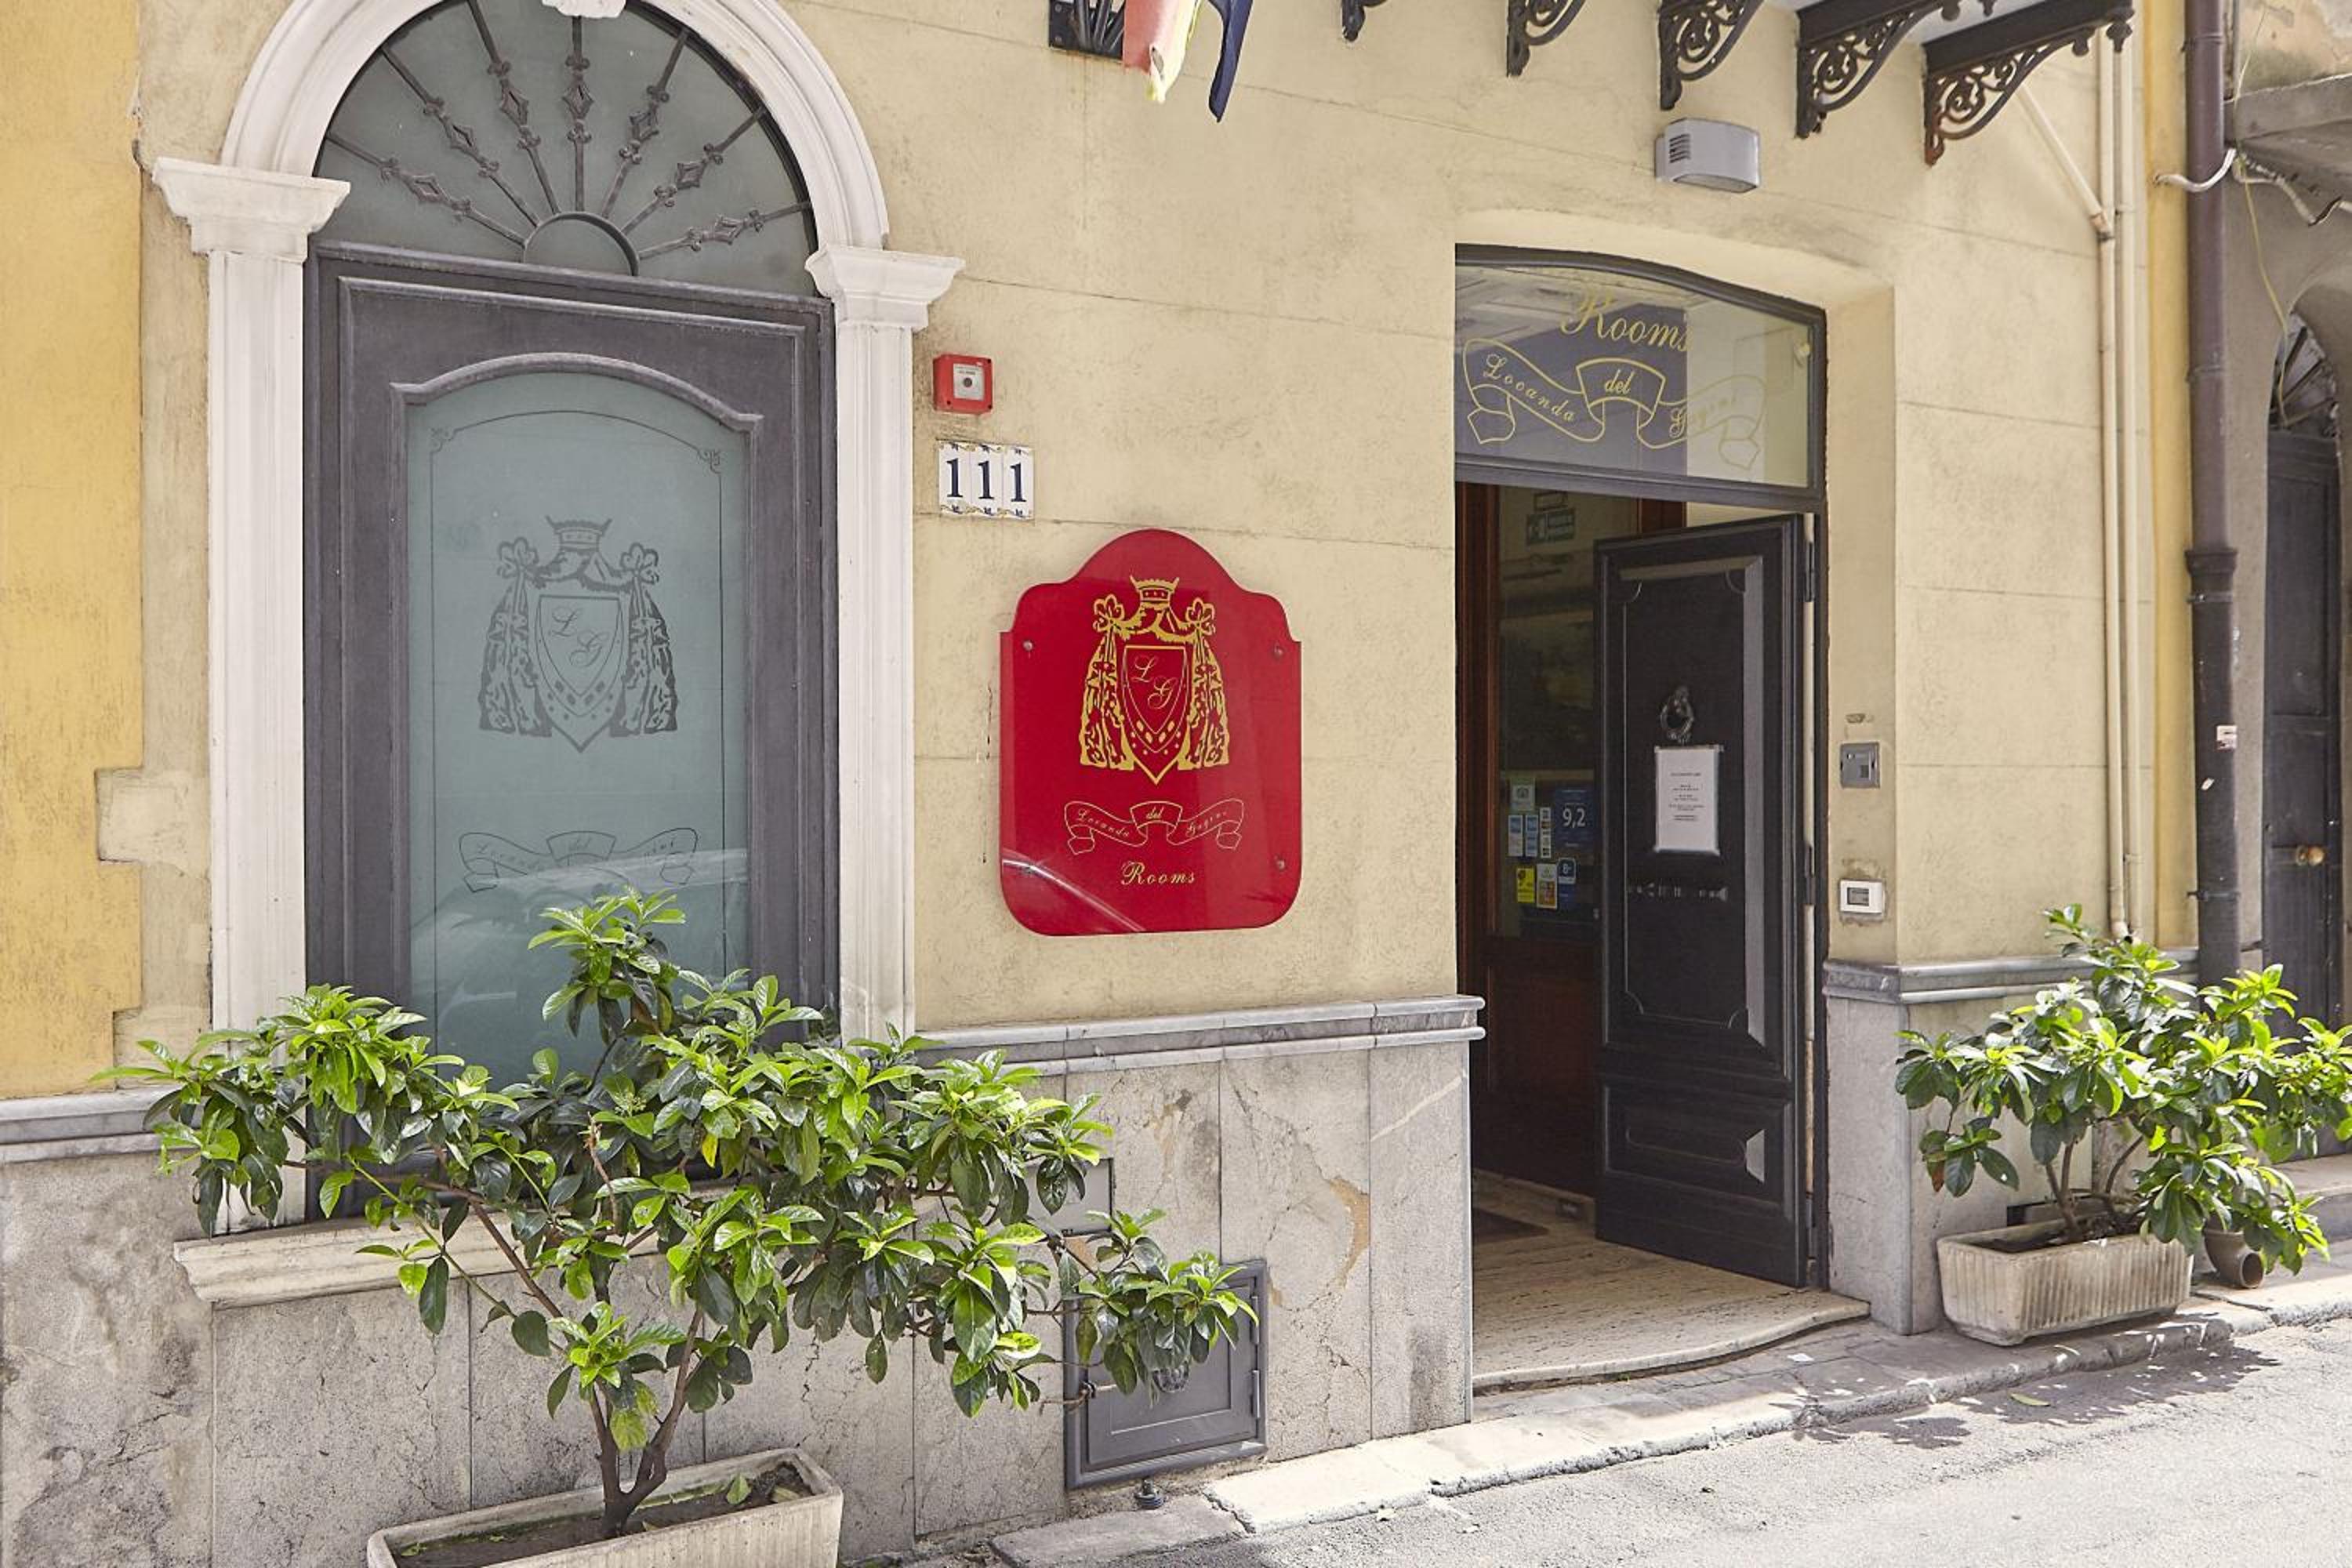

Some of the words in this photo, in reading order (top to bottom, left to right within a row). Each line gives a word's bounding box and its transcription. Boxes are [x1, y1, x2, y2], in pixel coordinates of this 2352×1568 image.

[1560, 287, 1692, 352] Rooms
[1603, 368, 1636, 395] del
[946, 457, 1027, 503] 111
[1145, 806, 1163, 820] del
[1563, 808, 1586, 828] 9,2
[1120, 860, 1196, 886] Rooms
